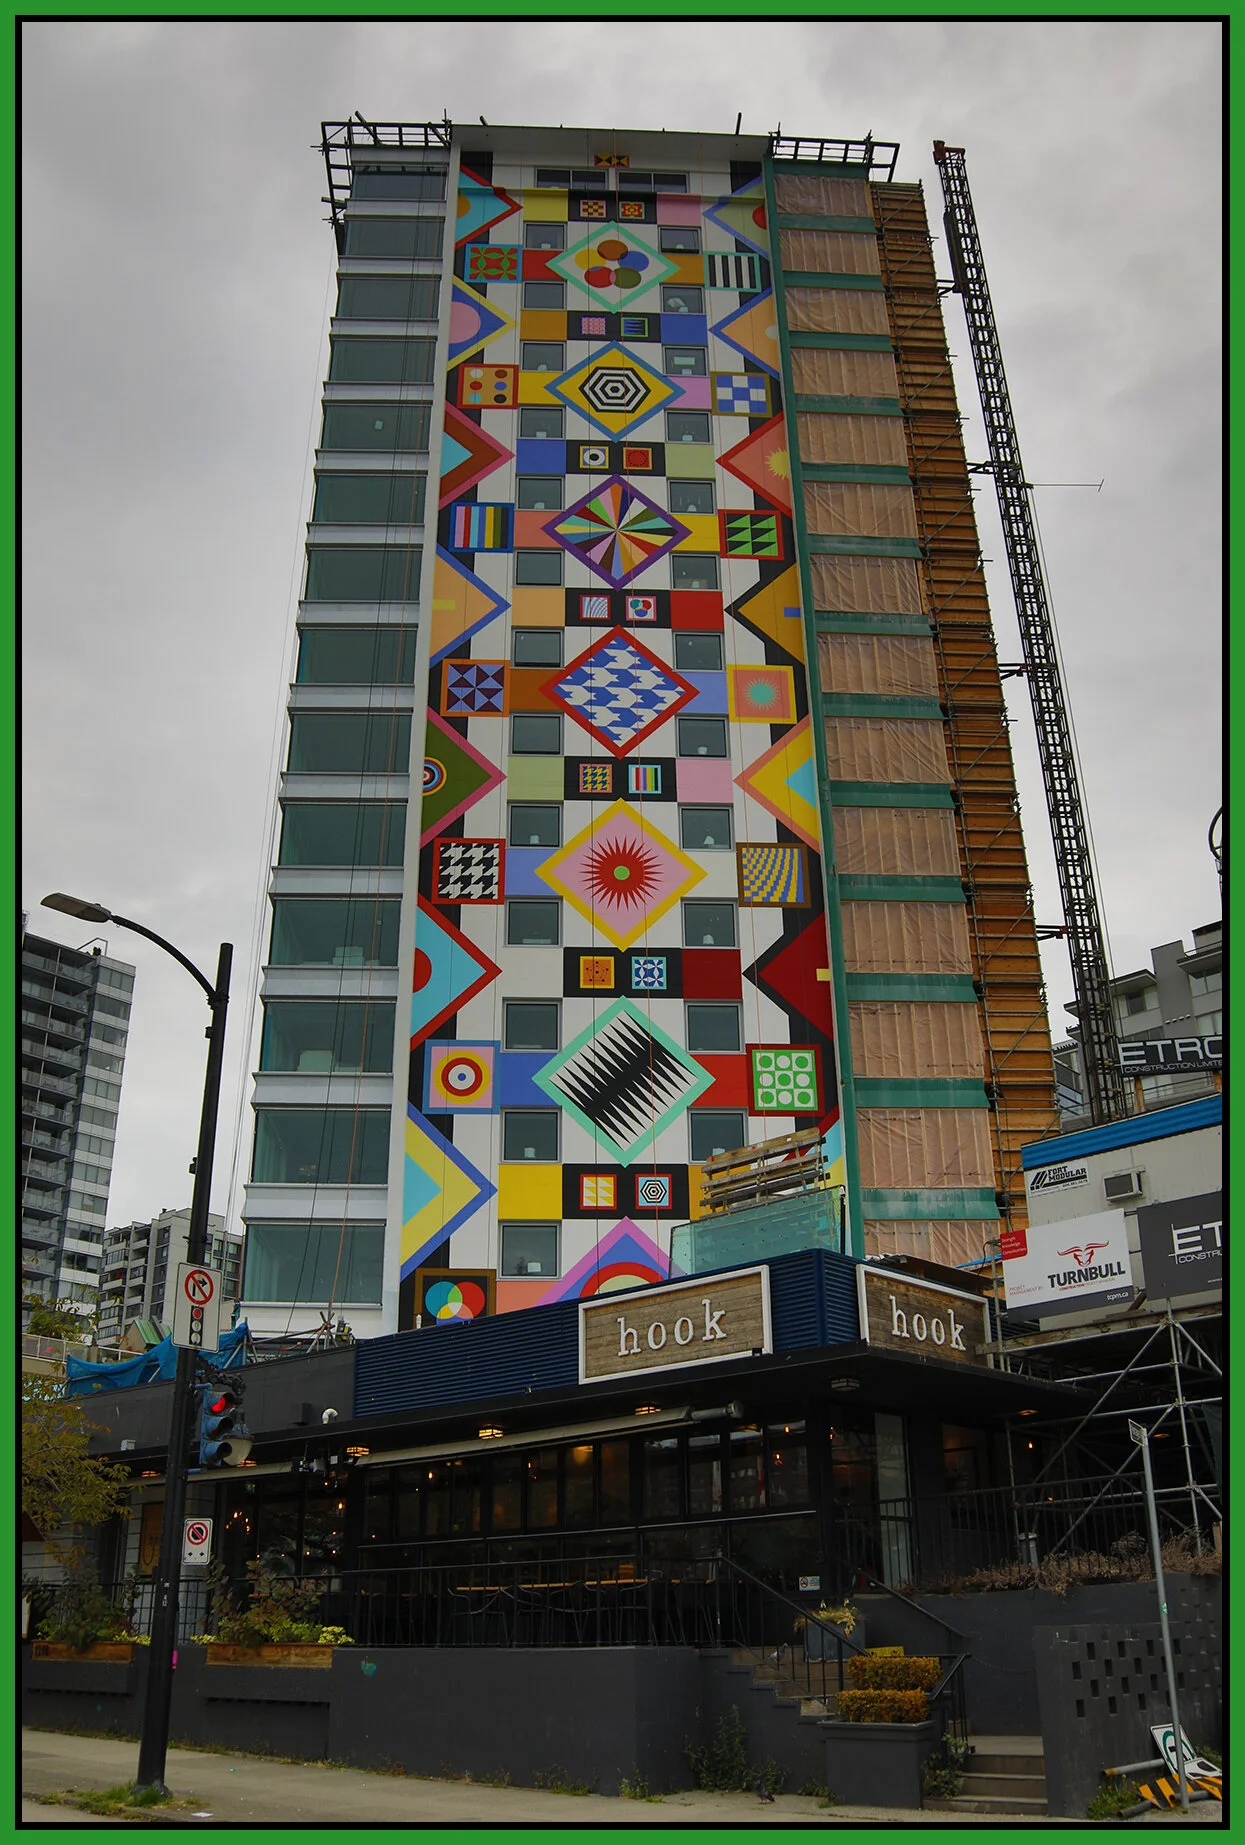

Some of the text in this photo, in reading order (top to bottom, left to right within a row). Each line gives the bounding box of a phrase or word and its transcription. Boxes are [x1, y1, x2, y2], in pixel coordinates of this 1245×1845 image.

[1124, 1061, 1197, 1074] CONSTRUCTION
[1048, 1165, 1068, 1176] FORT
[1048, 1167, 1087, 1181] MODULAR
[1047, 1261, 1126, 1288] TURNBULL
[1106, 1291, 1129, 1301] tcpm.ca
[617, 1298, 728, 1357] hook
[889, 1294, 967, 1351] hook
